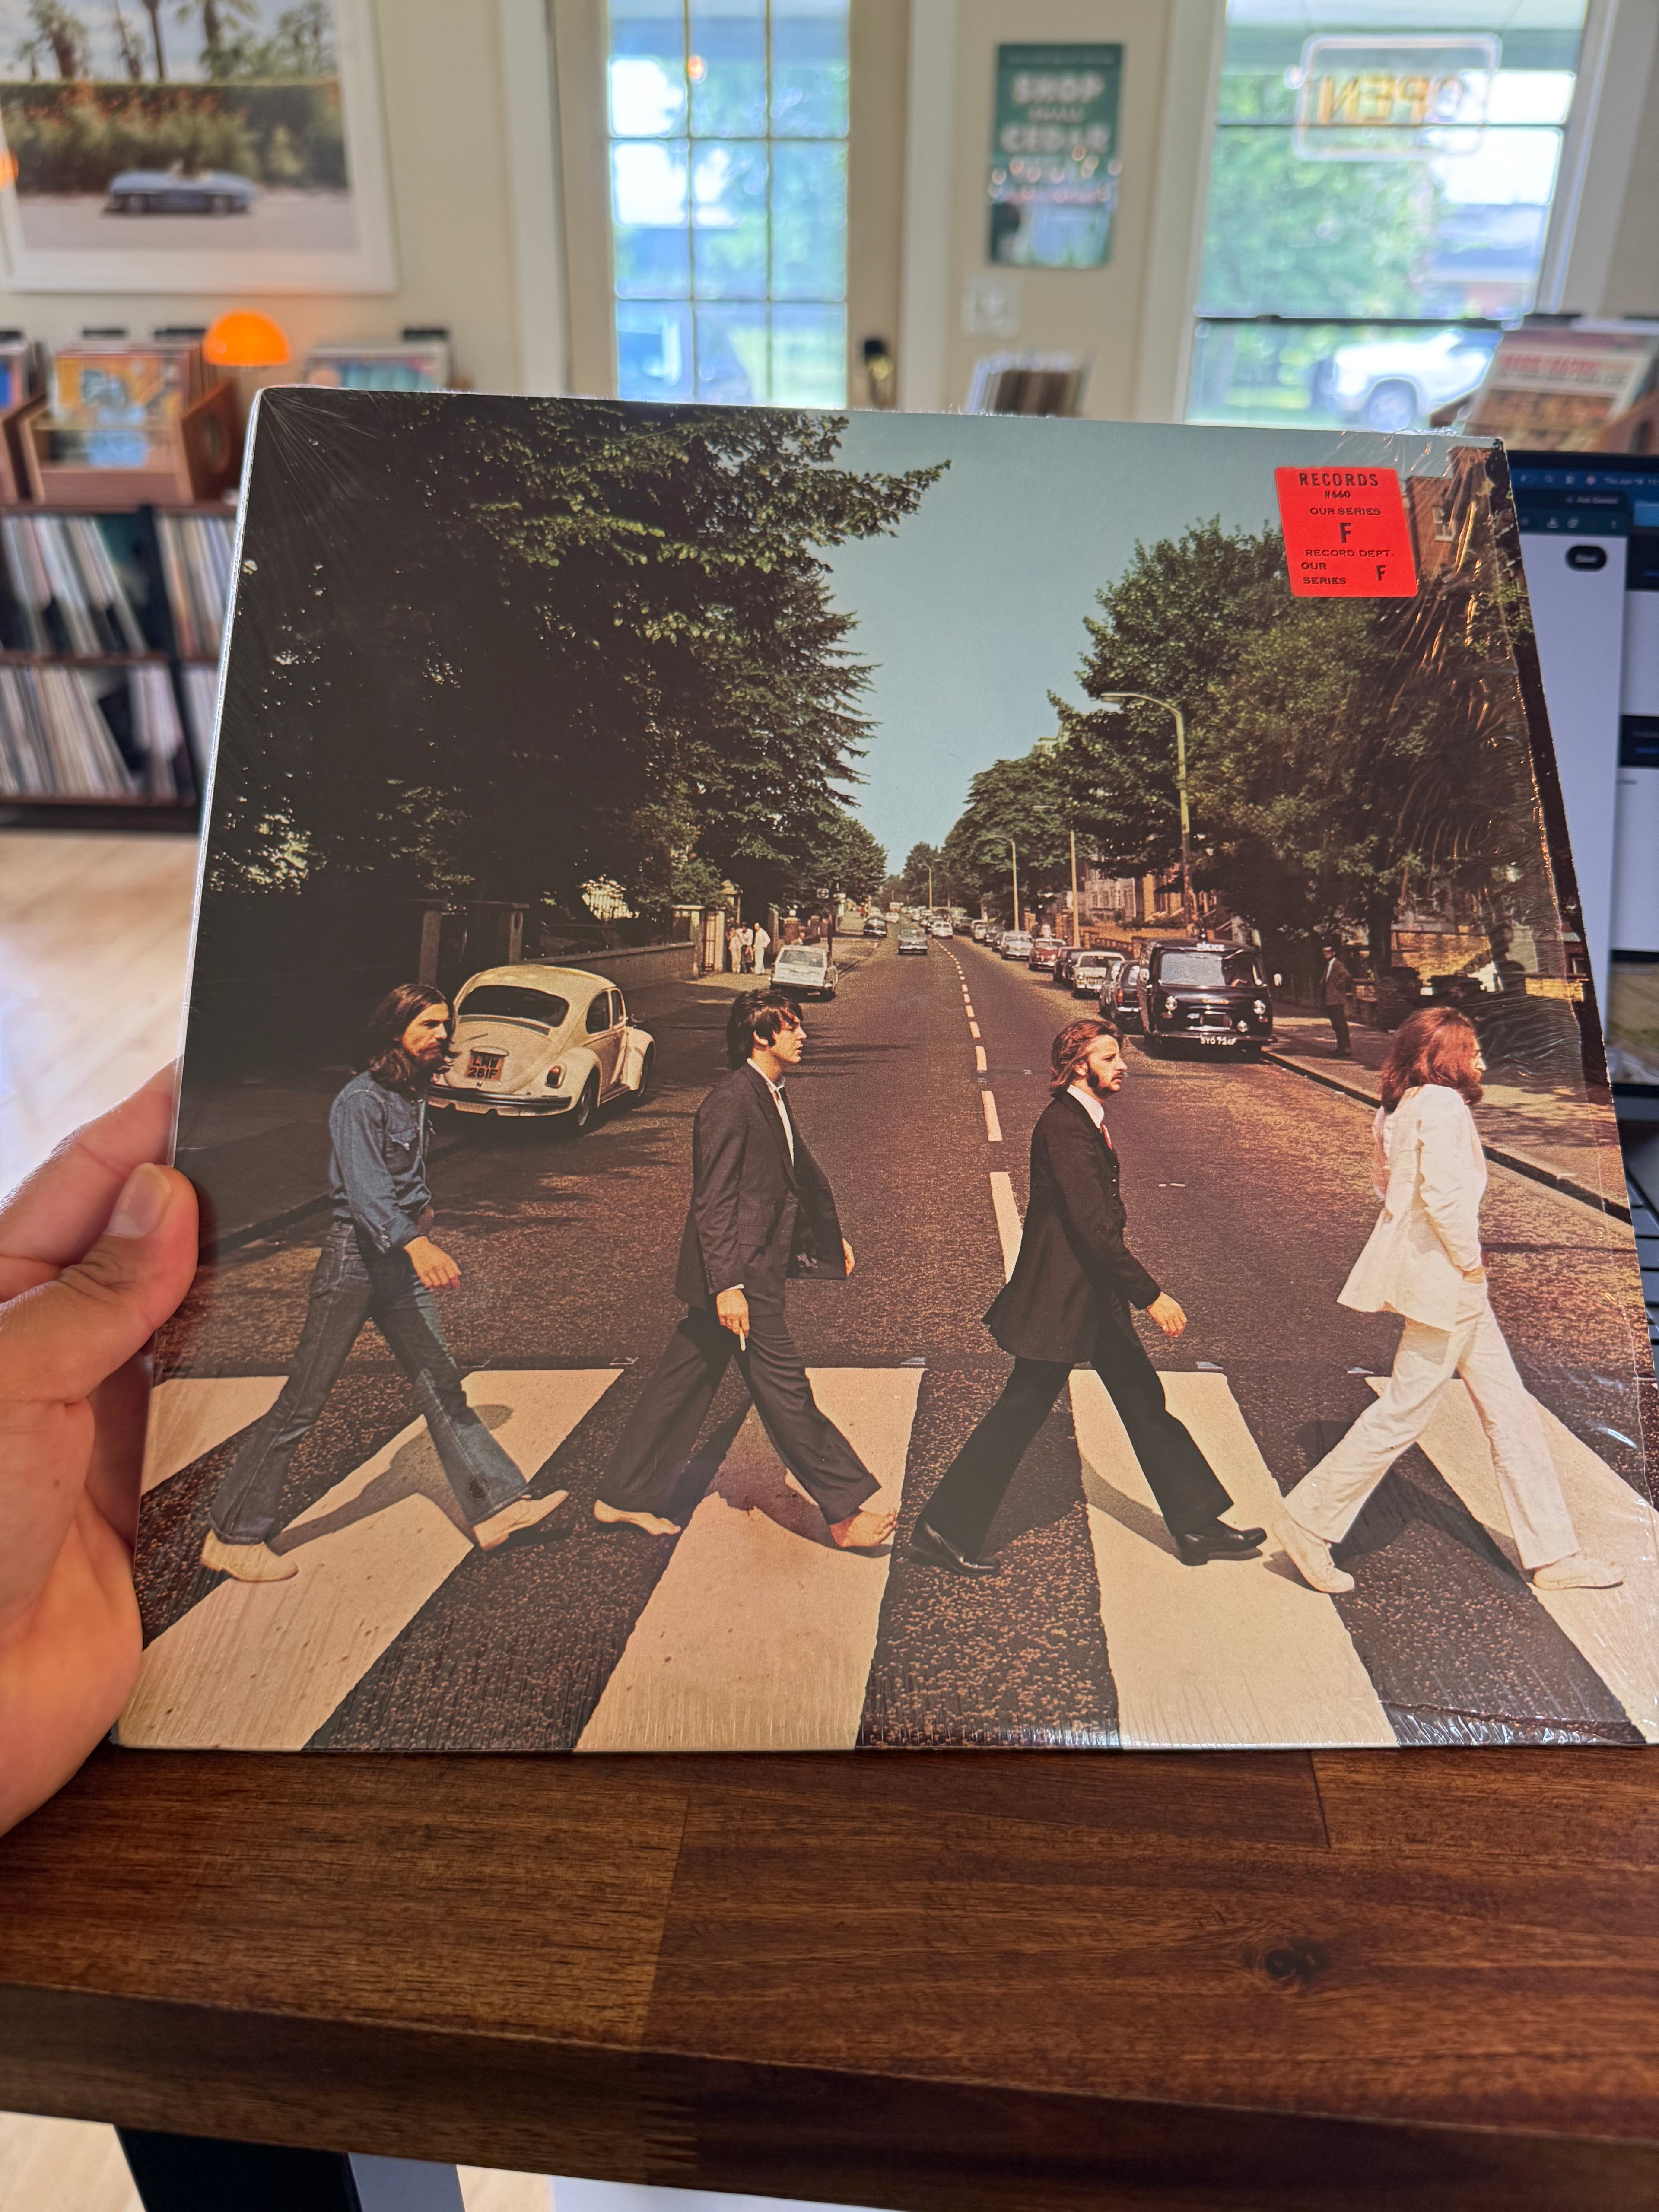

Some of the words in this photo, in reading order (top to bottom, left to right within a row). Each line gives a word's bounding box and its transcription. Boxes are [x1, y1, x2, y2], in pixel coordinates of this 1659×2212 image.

[1299, 472, 1379, 487] RECORDS
[1325, 490, 1351, 499] #660
[1339, 522, 1351, 544] F
[1305, 549, 1355, 557] RECORD
[1300, 562, 1327, 570] OUR
[1376, 564, 1386, 581] F
